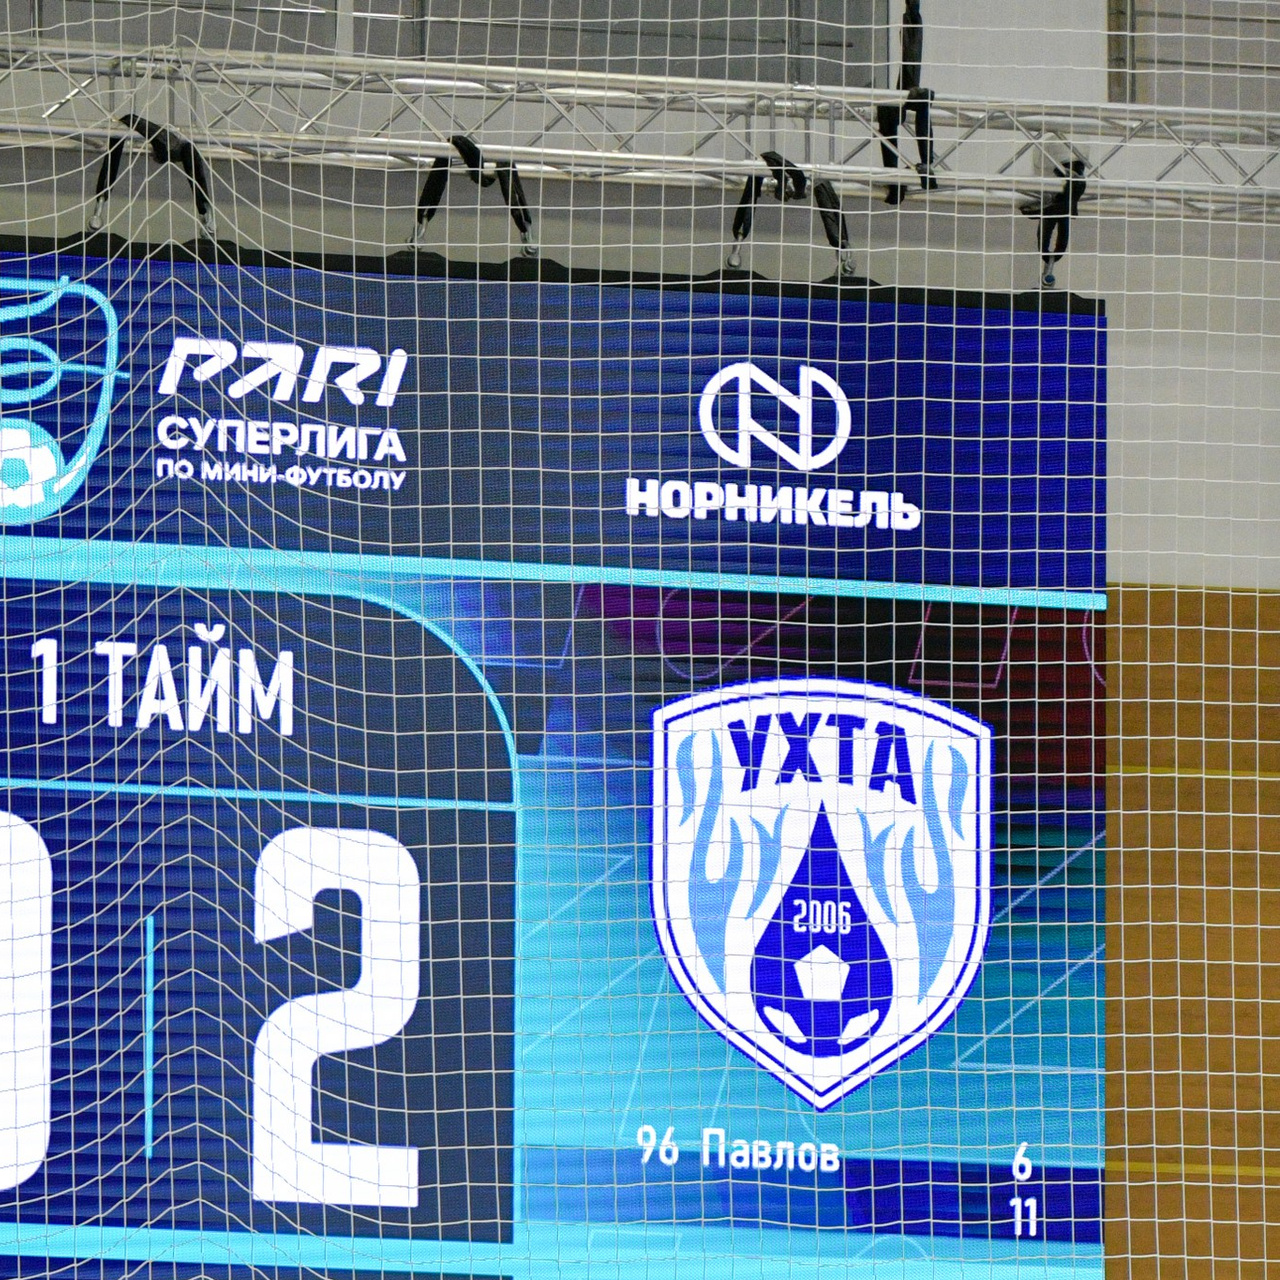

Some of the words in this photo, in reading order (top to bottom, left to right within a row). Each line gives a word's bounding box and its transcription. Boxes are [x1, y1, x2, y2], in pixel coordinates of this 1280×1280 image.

[158, 337, 407, 406] PARI
[157, 415, 406, 461] СУПЕРЛИГА
[157, 461, 194, 481] ПО
[201, 463, 406, 490] МИНИ-ФУТБОЛУ
[626, 477, 921, 530] НОРНИКЕЛЬ
[30, 638, 57, 724] 1
[95, 622, 294, 735] ТАЙМ
[728, 712, 917, 804] УХТА
[793, 899, 851, 934] 2006
[253, 827, 420, 1208] 2
[637, 1125, 679, 1165] 96
[701, 1128, 840, 1172] Павлов
[1012, 1142, 1032, 1181] 6
[1009, 1197, 1037, 1237] 11
